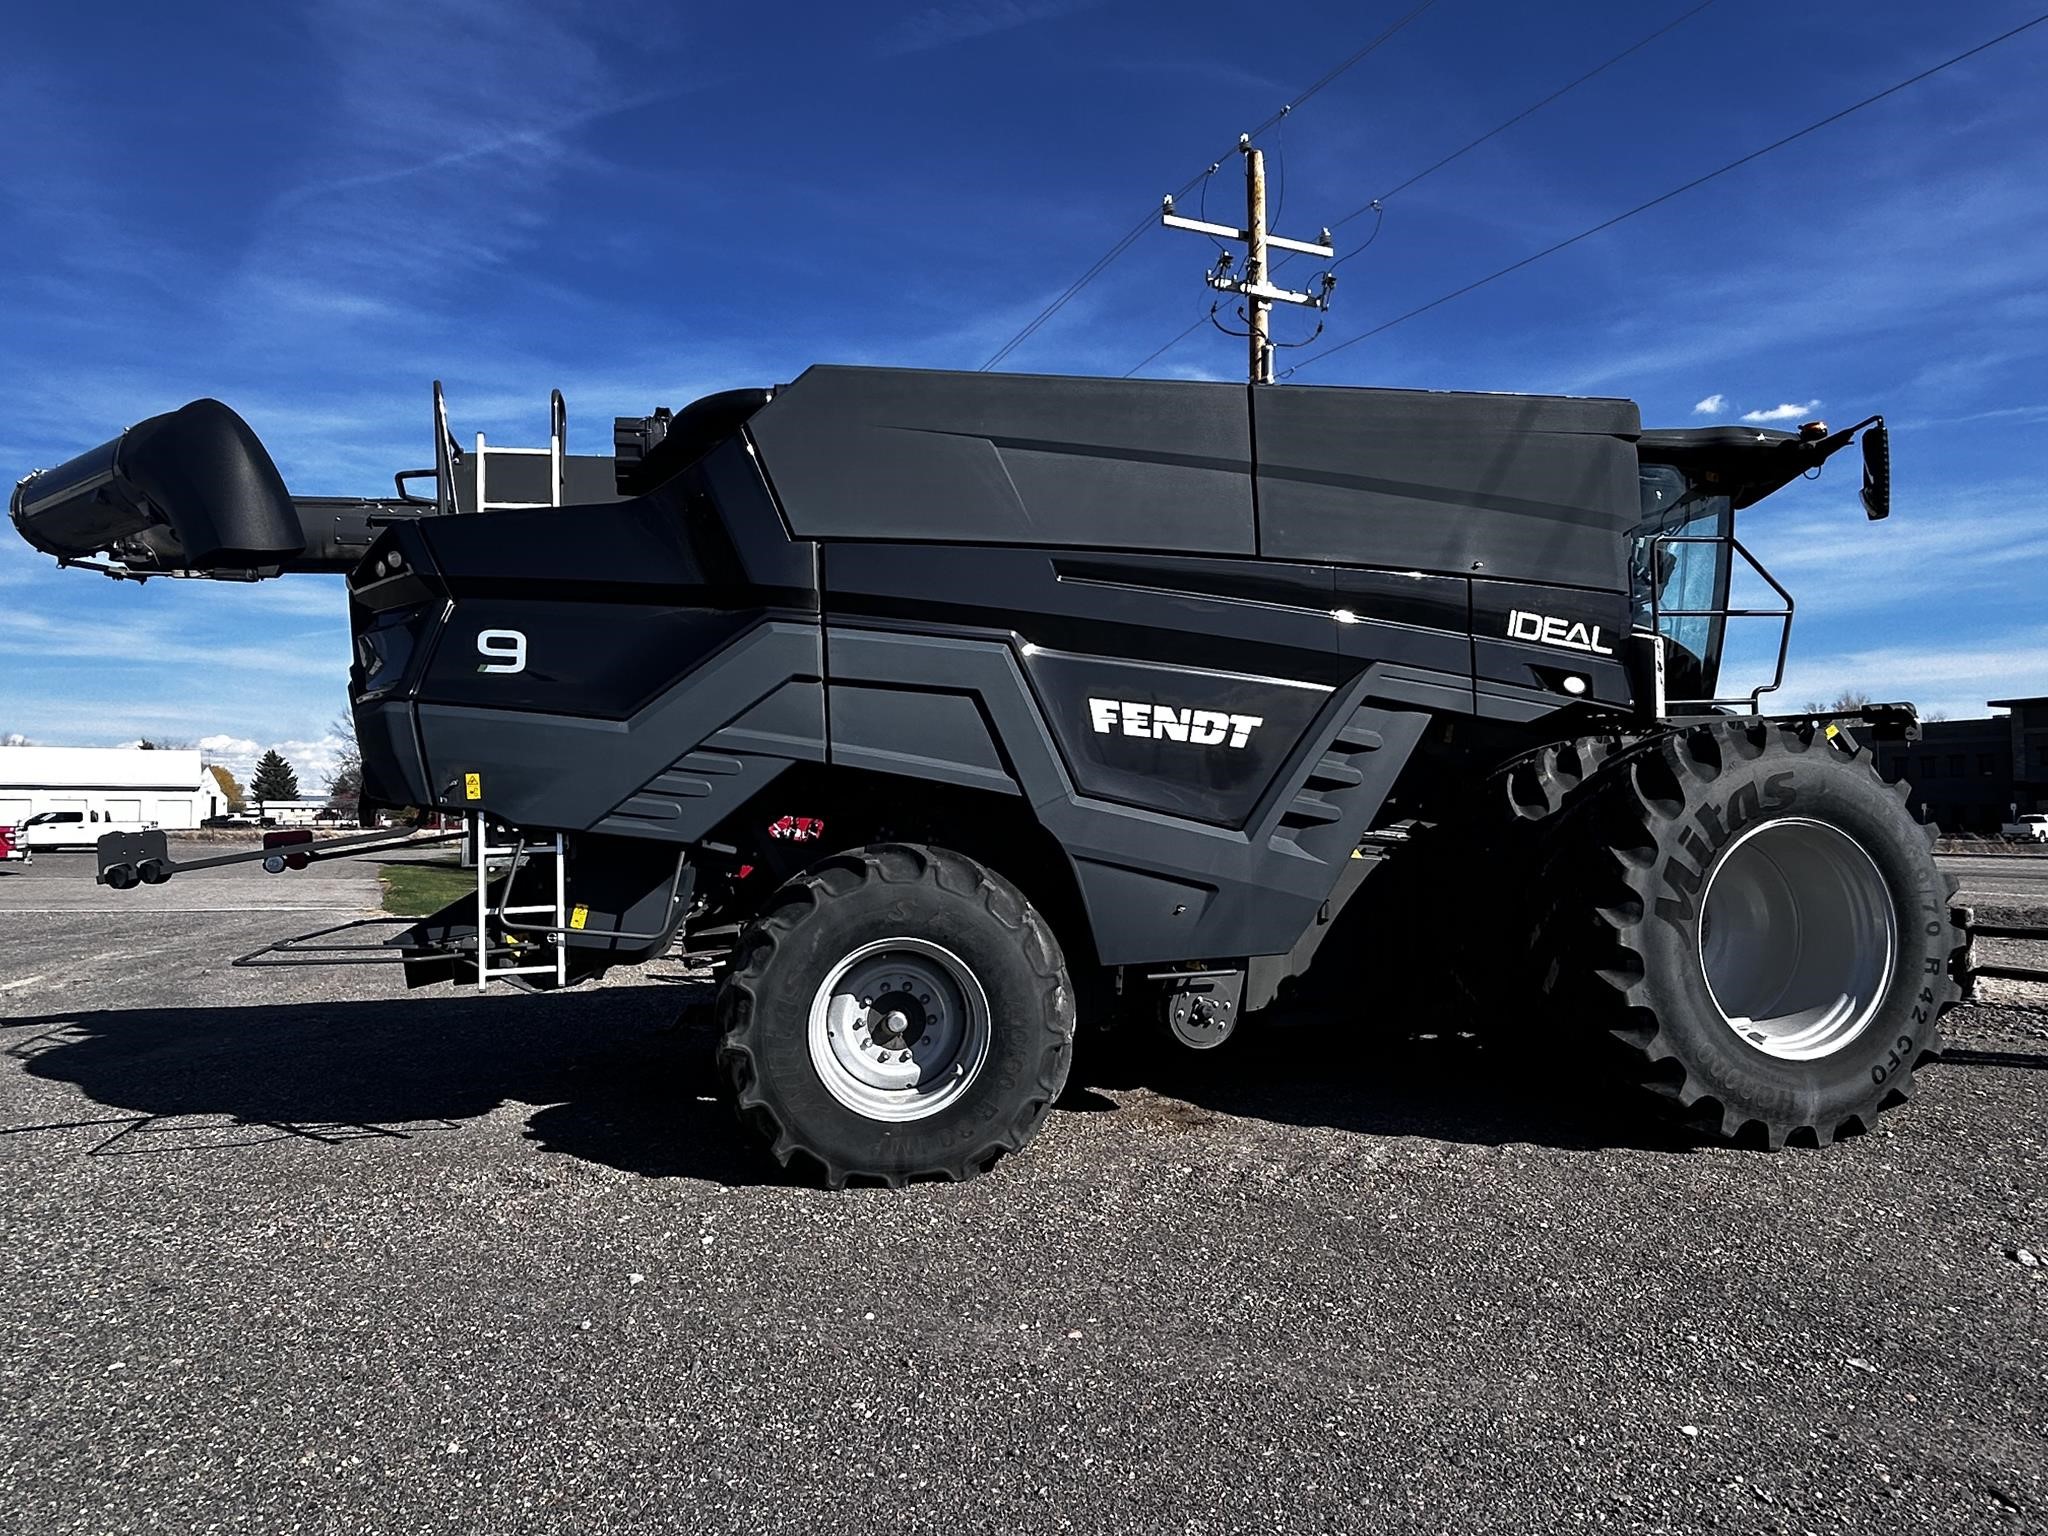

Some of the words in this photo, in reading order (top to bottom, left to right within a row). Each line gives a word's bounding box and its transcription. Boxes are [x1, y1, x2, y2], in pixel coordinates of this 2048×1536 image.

[477, 629, 527, 674] 9
[1507, 610, 1613, 655] IDEAL
[1088, 698, 1264, 749] FENDT
[1655, 771, 1797, 951] Mitas
[1924, 957, 1941, 976] R
[1912, 986, 1934, 1025] 42
